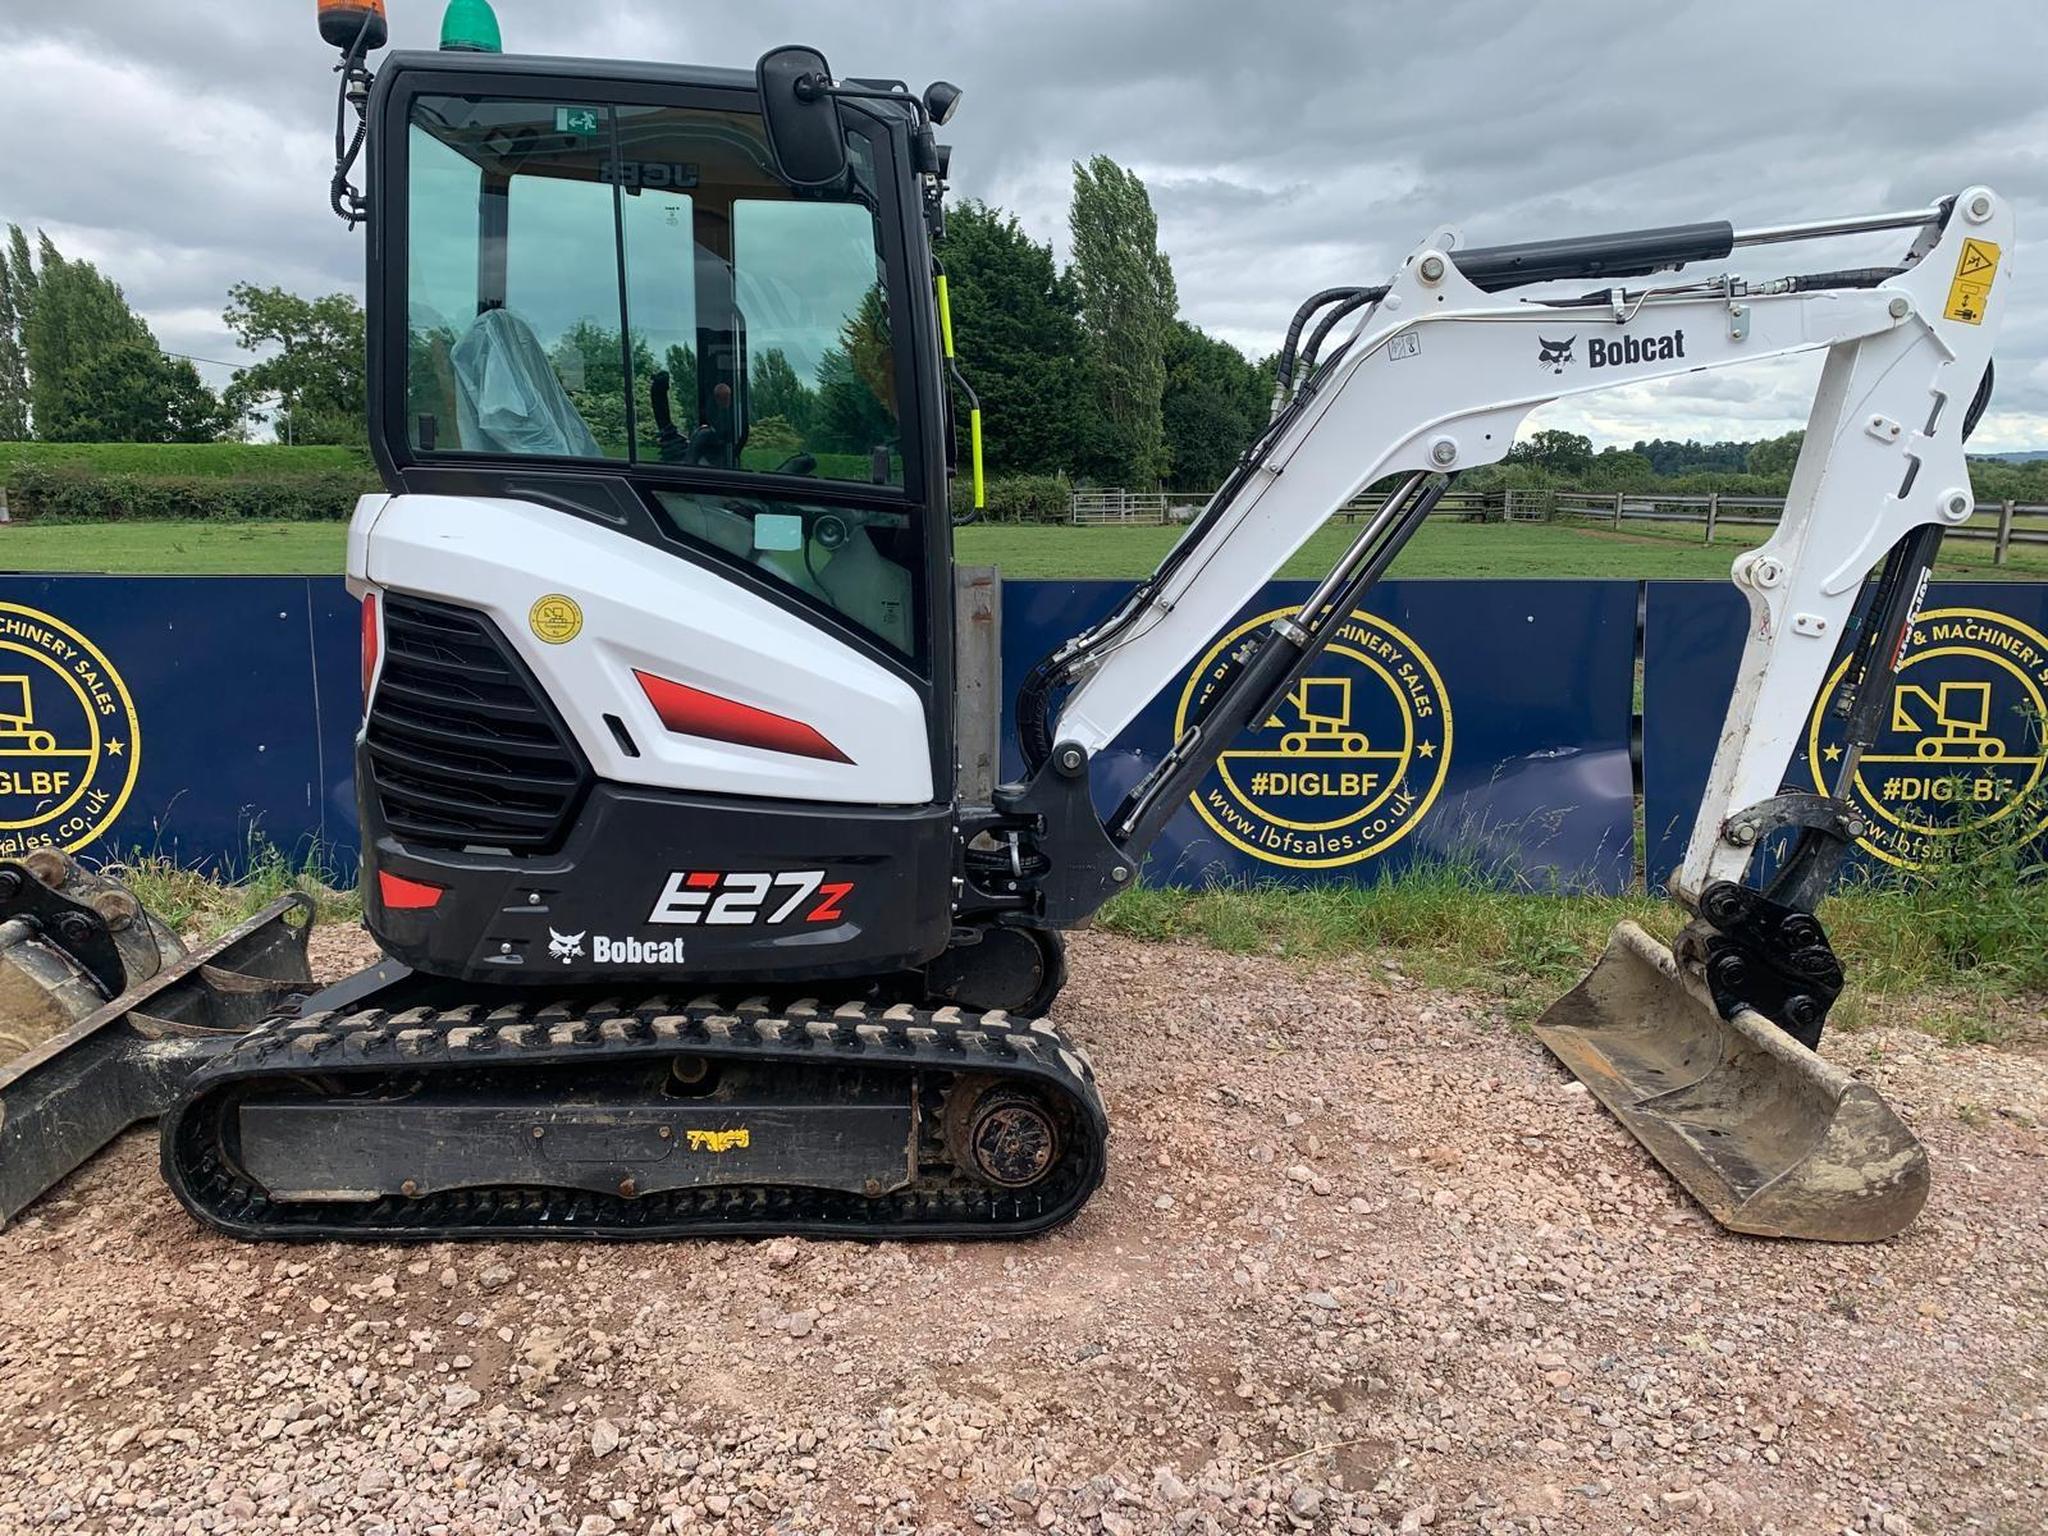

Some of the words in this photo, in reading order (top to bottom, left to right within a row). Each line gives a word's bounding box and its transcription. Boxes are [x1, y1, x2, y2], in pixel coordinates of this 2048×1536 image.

[1588, 330, 1685, 368] Bobcat
[1912, 631, 1928, 646] &
[1932, 624, 2044, 668] MACHINERY
[75, 660, 116, 715] SALES
[1398, 663, 1432, 717] SALES
[1251, 773, 1379, 796] #DIGLBF
[1208, 788, 1416, 854] www.lbfsales.co.uk
[593, 936, 684, 964] Bobcat
